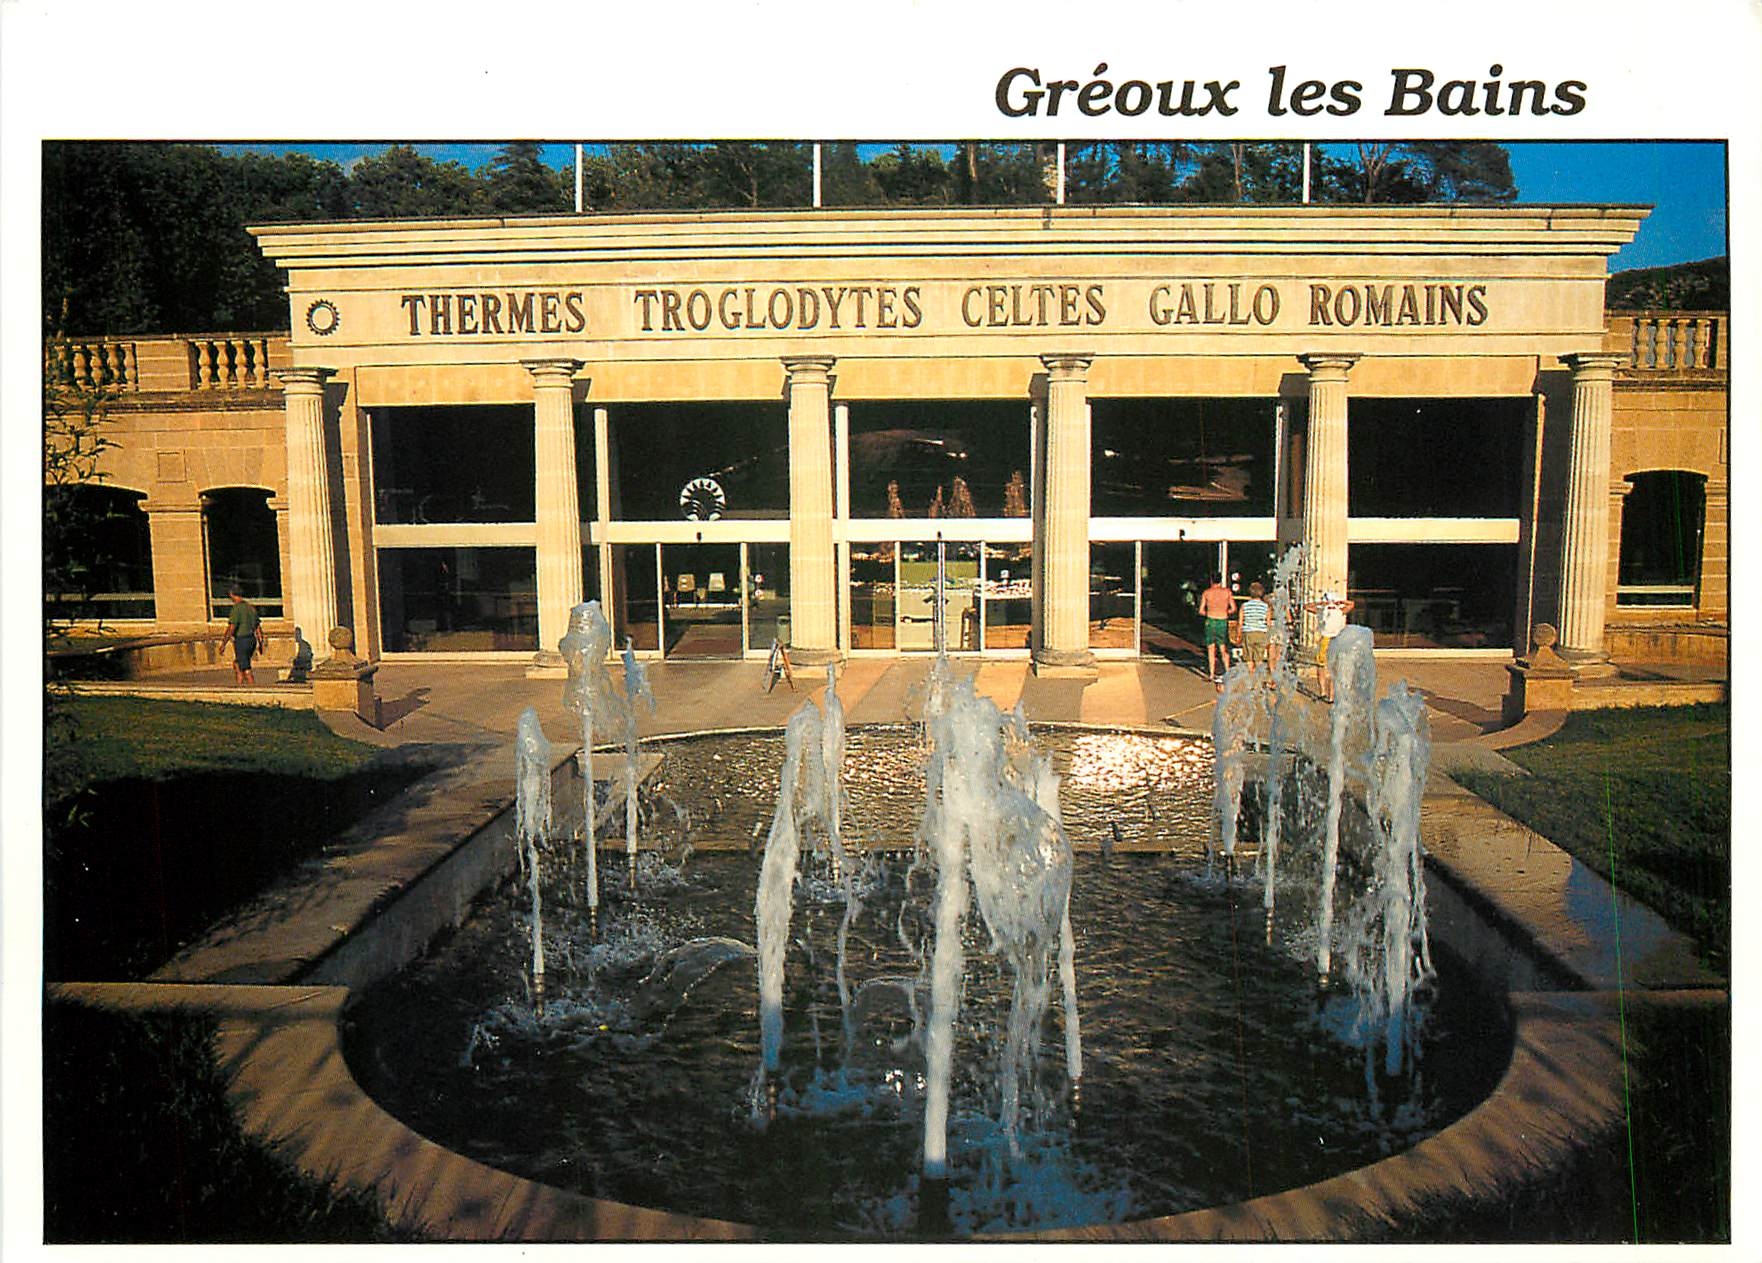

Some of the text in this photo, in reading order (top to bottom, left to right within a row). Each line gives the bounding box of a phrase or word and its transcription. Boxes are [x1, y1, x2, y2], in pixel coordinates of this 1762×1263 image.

[401, 282, 1489, 336] THERMES TROGLODYTES CELTES GALLO ROMAINS
